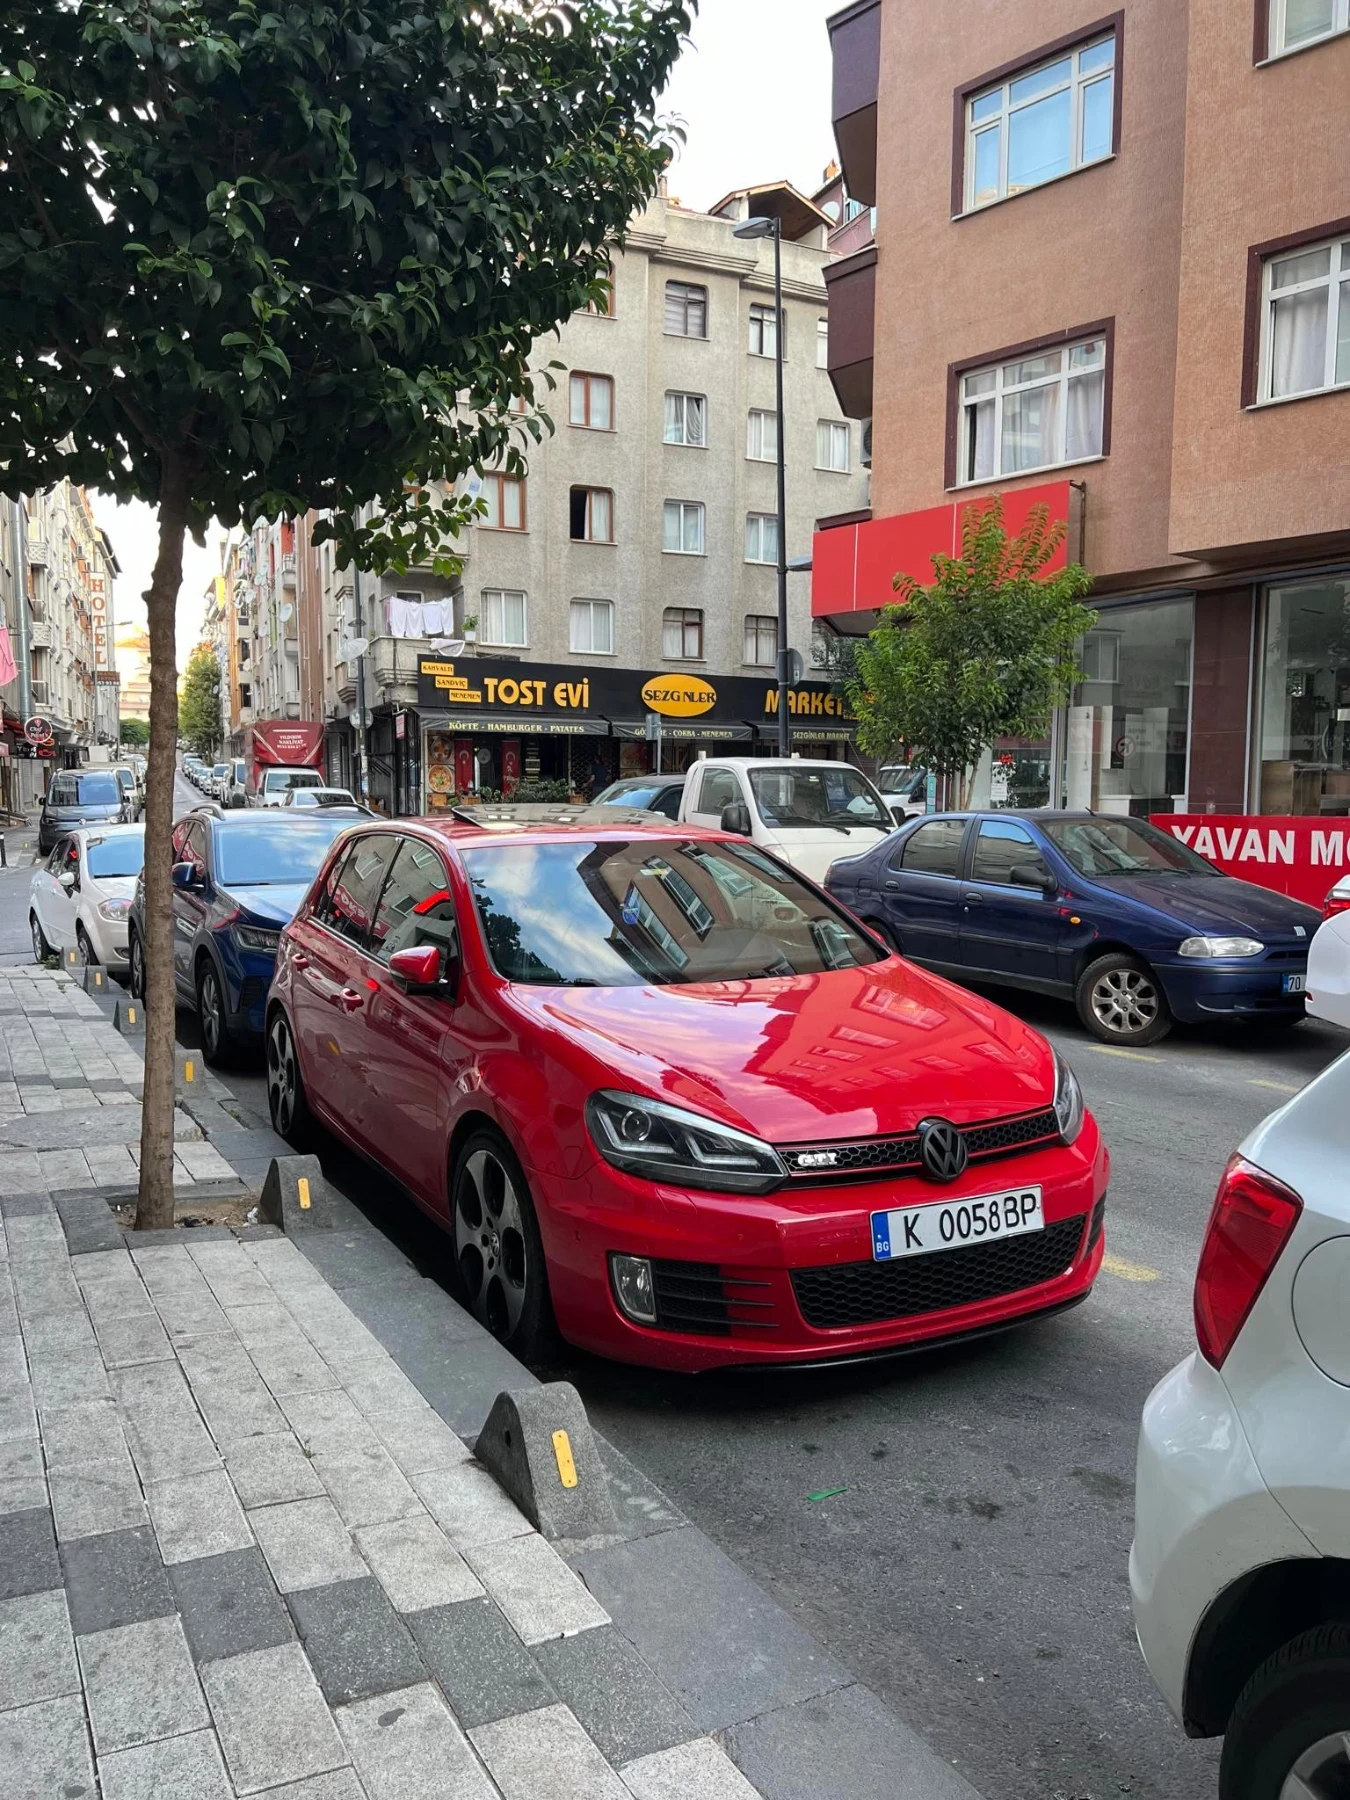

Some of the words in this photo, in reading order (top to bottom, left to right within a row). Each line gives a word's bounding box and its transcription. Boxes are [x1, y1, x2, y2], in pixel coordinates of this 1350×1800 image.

[91, 579, 106, 665] HOTEL
[484, 677, 547, 705] TOST
[553, 677, 589, 708] EVİ
[448, 721, 479, 730] KÖFTE
[487, 723, 543, 732] HAMBURGER
[550, 725, 585, 733] PATATES
[673, 729, 696, 738] ÇORBA
[701, 730, 733, 738] MENEMEN
[1170, 825, 1296, 865] YAVAN
[1310, 830, 1350, 867] M
[1289, 976, 1301, 990] 70
[797, 1152, 838, 1167] GTI
[903, 1213, 923, 1249] K
[876, 1241, 889, 1253] BG
